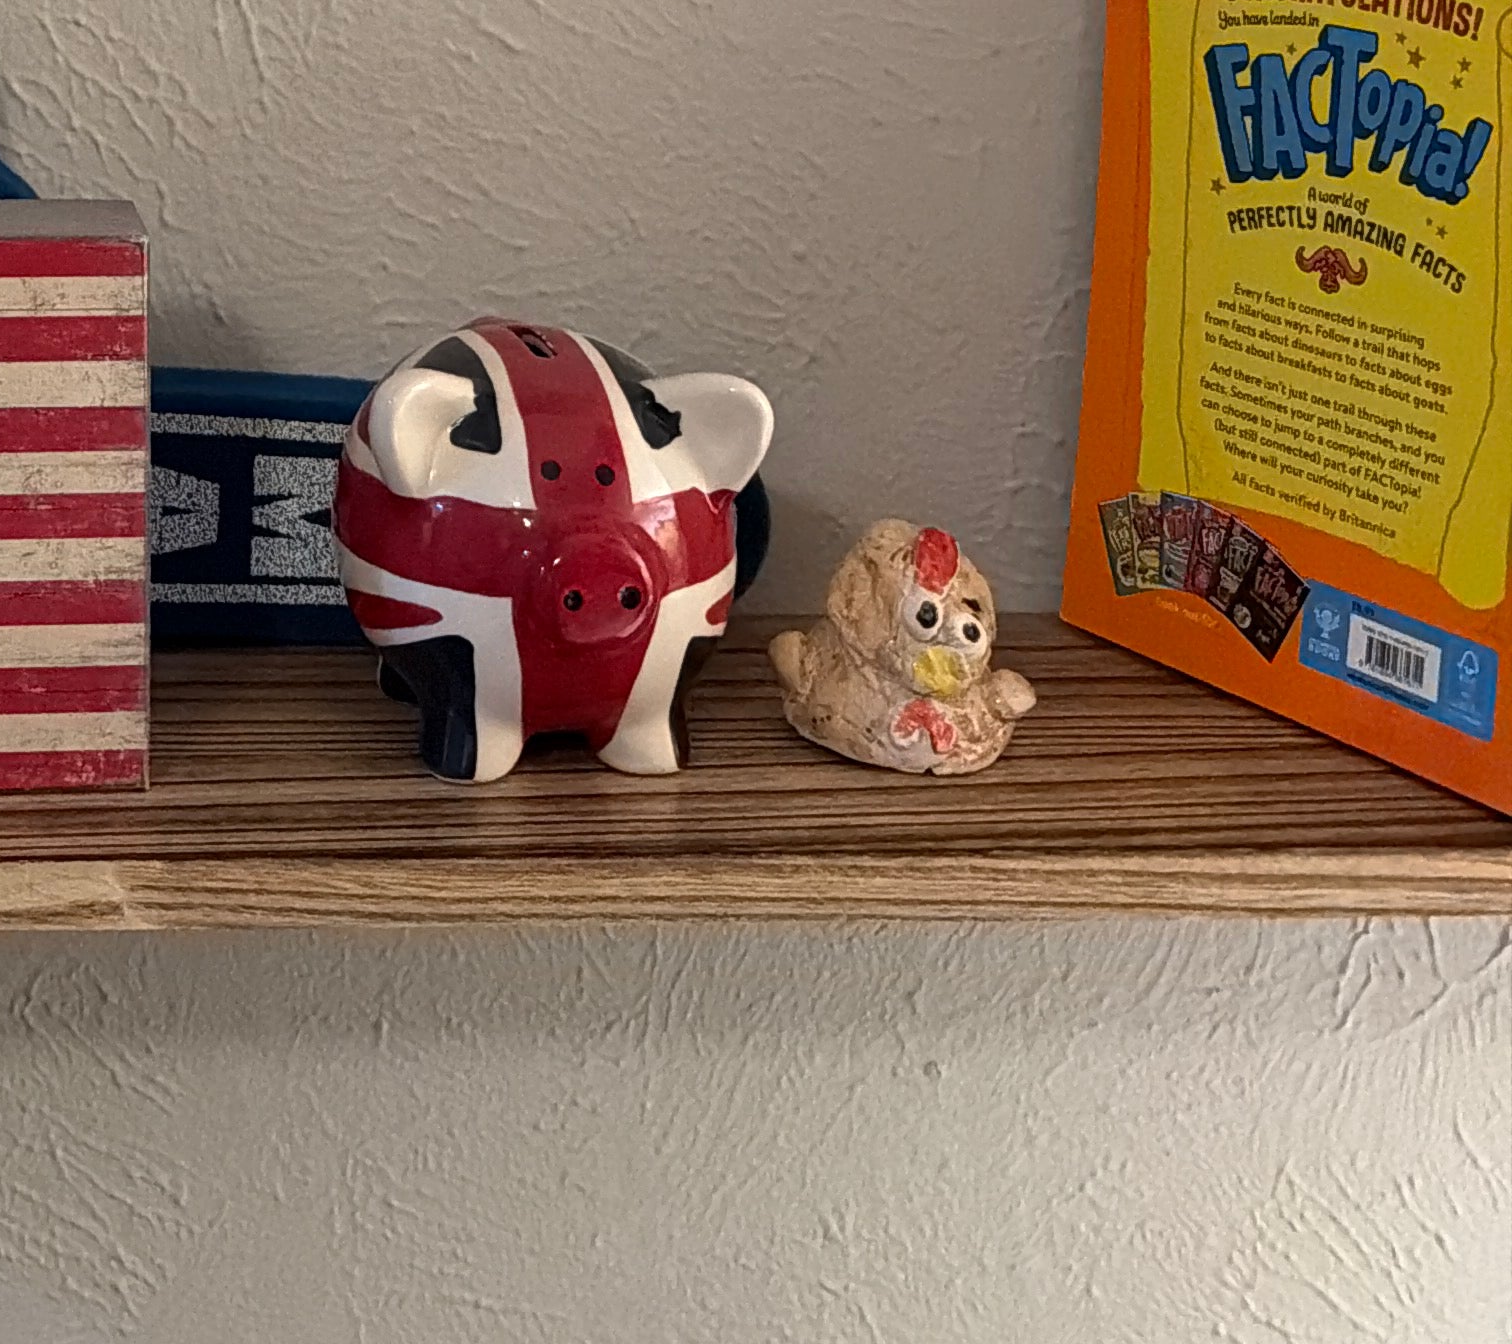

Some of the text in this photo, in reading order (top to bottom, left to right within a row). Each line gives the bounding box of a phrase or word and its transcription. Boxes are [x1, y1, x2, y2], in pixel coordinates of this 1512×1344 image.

[1218, 10, 1320, 30] You have landed in
[1203, 24, 1494, 205] FACTopia!
[1308, 186, 1370, 215] A world of
[1226, 204, 1466, 294] PERFECTLY AMAZING FACTS
[1204, 311, 1453, 396] from facts about dinosaurs to facts about eggs
[1217, 298, 1441, 373] and hilarious ways. Follow a trail that hops
[1234, 281, 1425, 350] Every fact is connected in surprising
[1205, 331, 1448, 415] to facts about breakfasts to facts about goats.
[1210, 362, 1232, 377] And
[1234, 369, 1262, 388] there
[1286, 384, 1308, 402] just
[1310, 394, 1331, 409] one
[1332, 400, 1356, 416] trail
[1357, 406, 1403, 433] through
[1405, 422, 1437, 442] these
[1201, 398, 1440, 485] can choose to jump to a completely different
[1214, 418, 1422, 500] (but still connected) part of FACTopia!
[1229, 385, 1288, 414] Sometimes
[1290, 407, 1316, 422] your
[1317, 416, 1342, 432] path
[1400, 443, 1422, 458] and
[1424, 452, 1446, 466] you
[1223, 439, 1409, 514] Where will your curiosity take you?
[1232, 470, 1396, 539] All facts verified by Britannica
